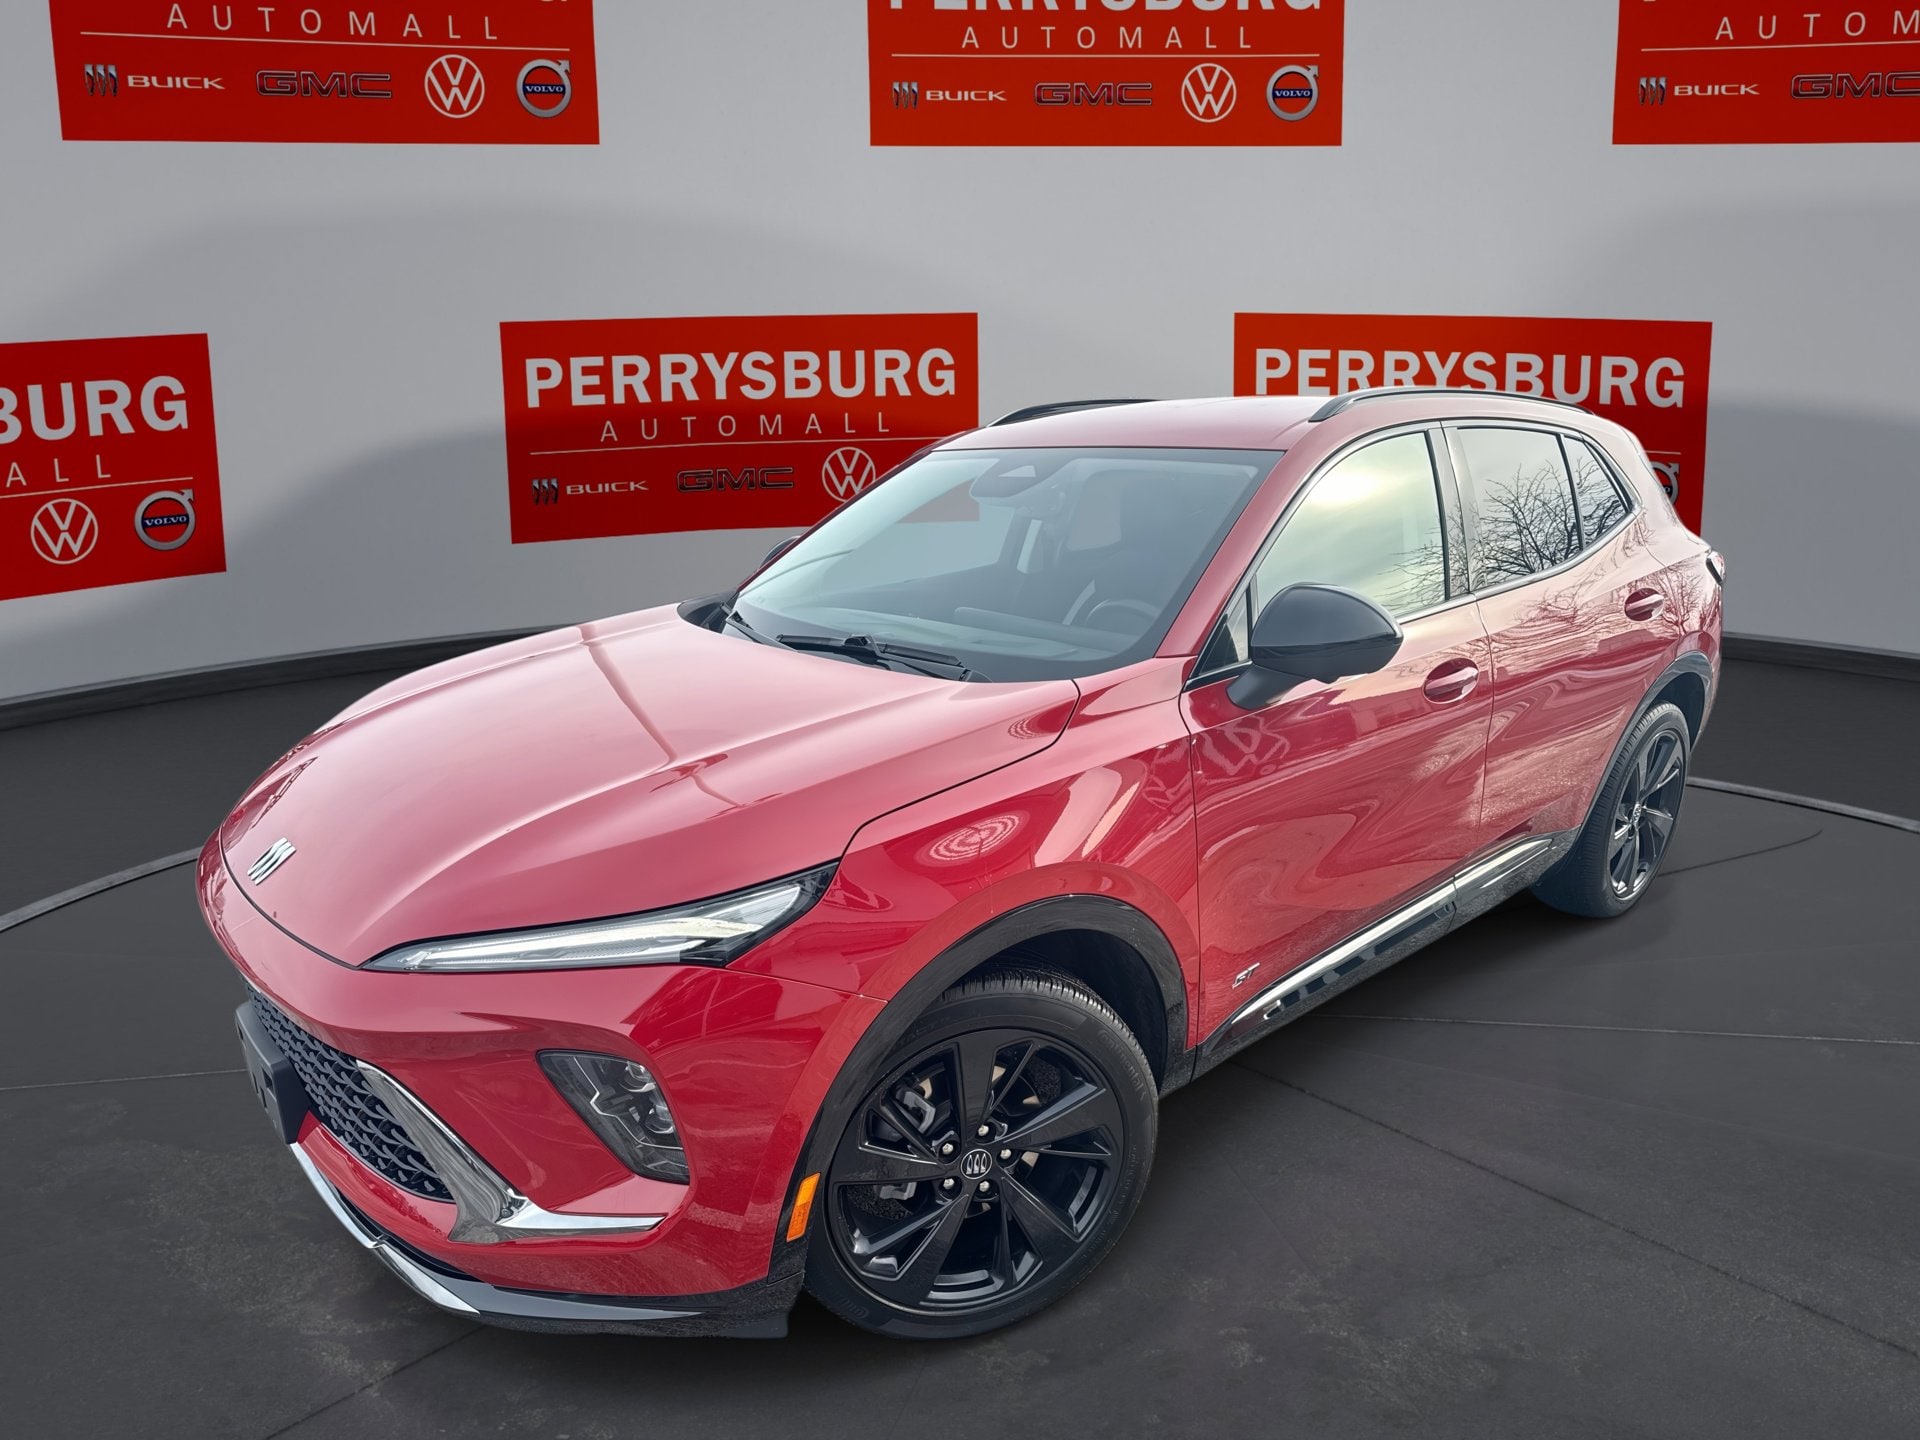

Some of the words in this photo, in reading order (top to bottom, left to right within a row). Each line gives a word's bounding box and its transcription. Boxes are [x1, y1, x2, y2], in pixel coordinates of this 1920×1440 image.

[167, 3, 498, 40] AUTOMALL
[1715, 9, 1920, 41] AUTOM
[961, 25, 1252, 49] AUTOMALL
[127, 74, 225, 90] BUICK
[256, 70, 393, 99] GMC
[525, 85, 564, 93] VOLVO
[925, 89, 1008, 101] BUICK
[1034, 81, 1153, 107] GMC
[1274, 88, 1312, 98] VOLVO
[1673, 83, 1760, 96] BUICK
[1791, 71, 1920, 99] GMC
[525, 347, 956, 408] PERRYSBURG
[1255, 348, 1685, 408] PERRYSBURG
[600, 411, 890, 442] AUTOMALL
[5, 454, 111, 488] ALL
[566, 480, 649, 496] BUICK
[677, 466, 794, 492] GMC
[144, 515, 188, 527] VOLVO
